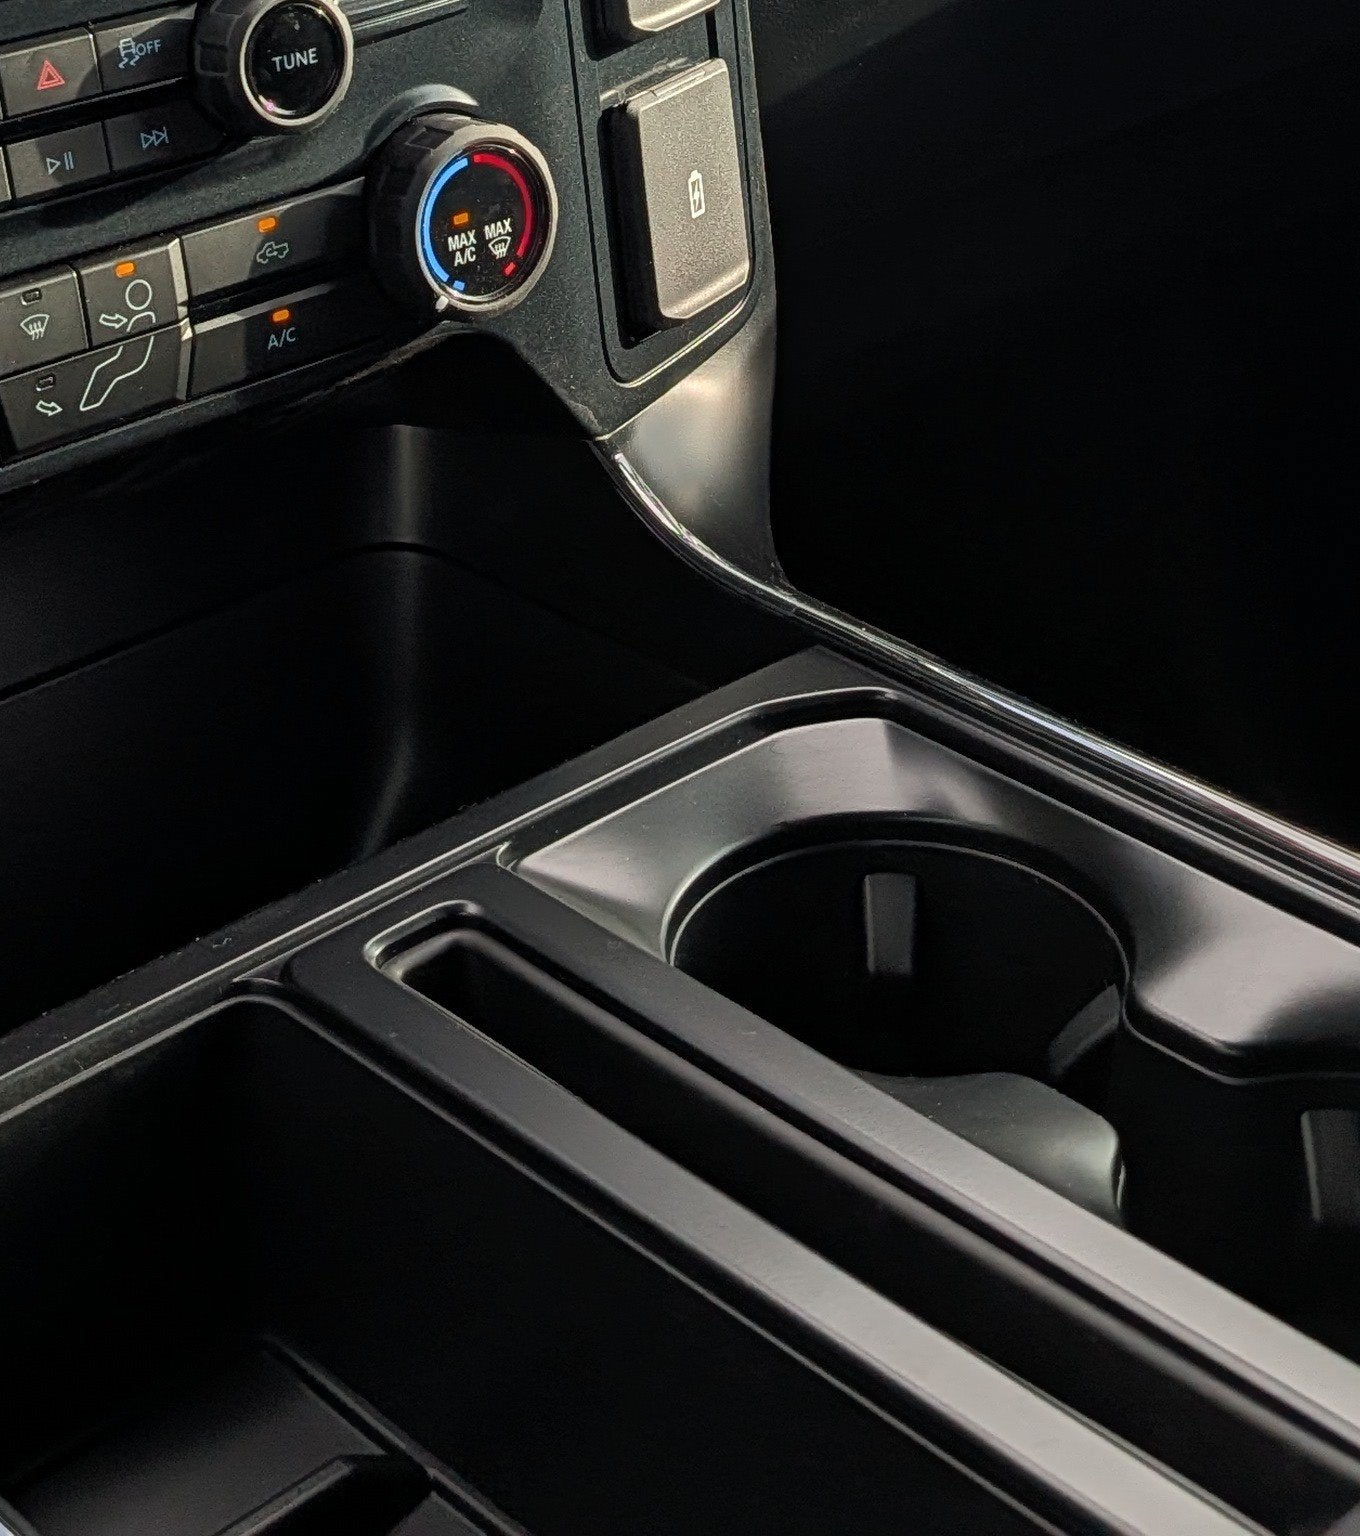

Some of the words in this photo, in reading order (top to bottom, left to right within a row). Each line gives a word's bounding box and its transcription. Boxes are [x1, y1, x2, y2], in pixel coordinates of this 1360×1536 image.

[135, 39, 162, 56] OFF
[271, 47, 319, 73] TUNE
[483, 217, 513, 240] MAX
[447, 229, 478, 252] MAX
[453, 246, 477, 267] A/C
[267, 326, 297, 351] A/C
